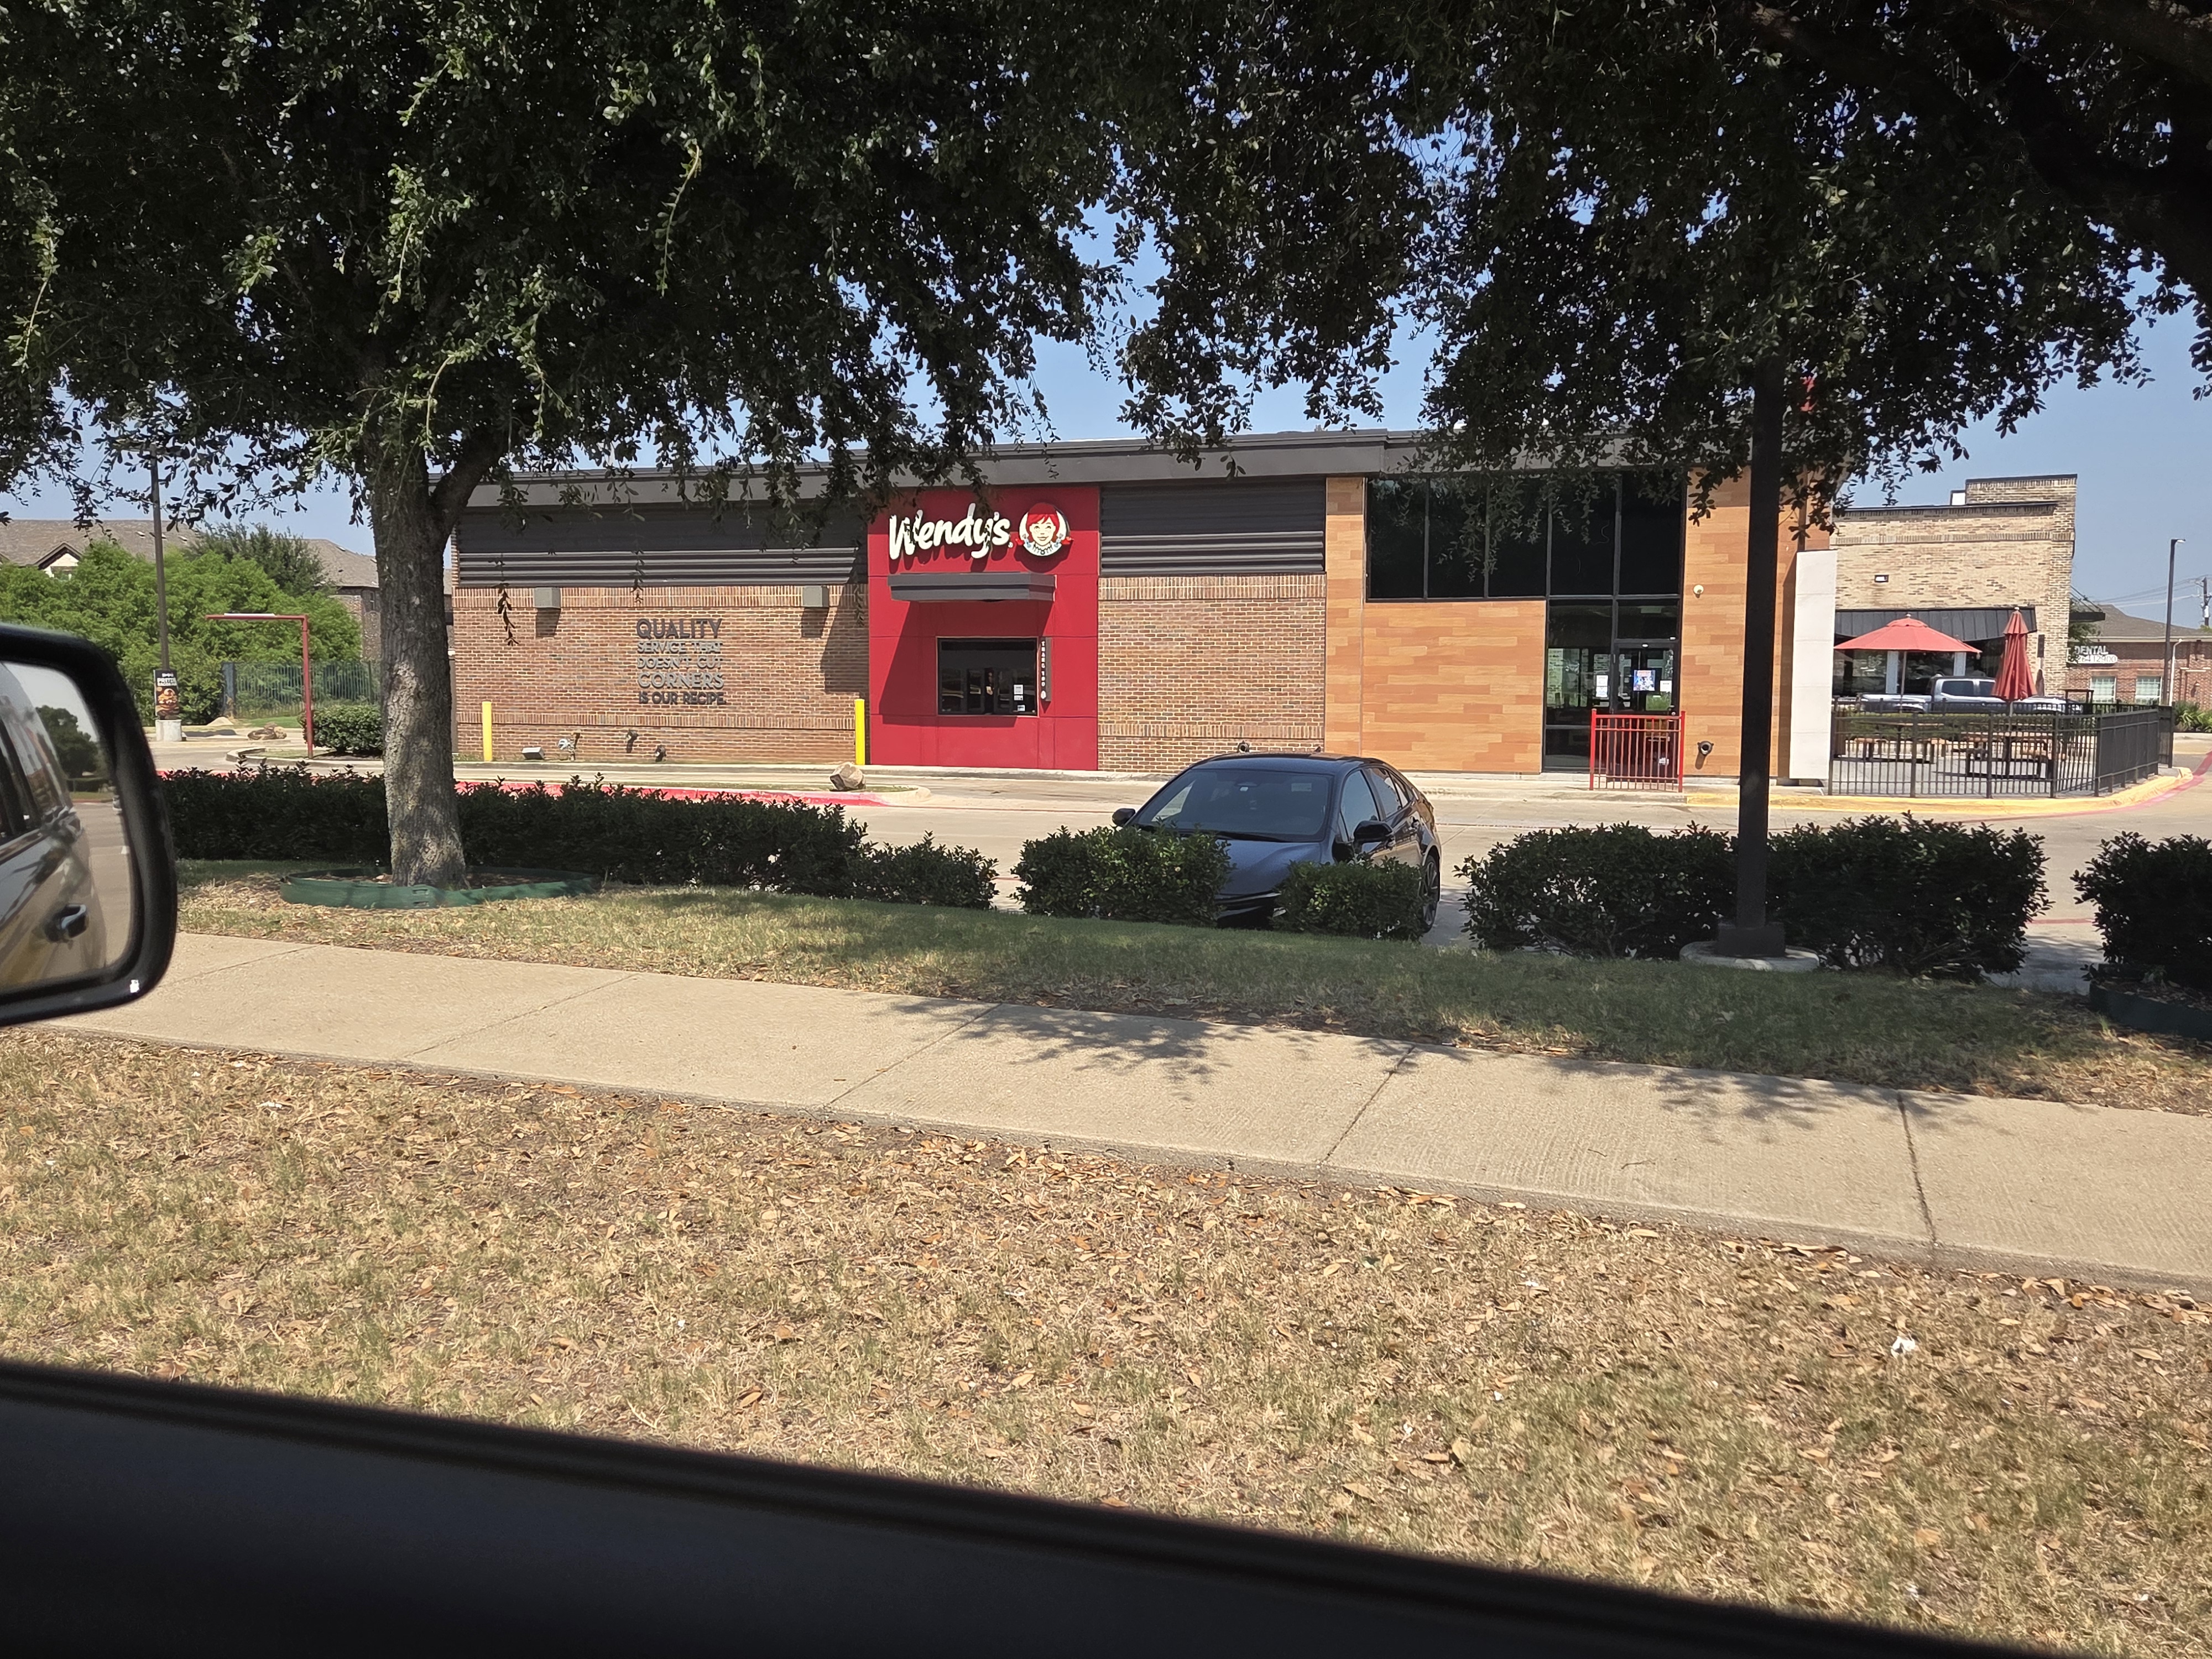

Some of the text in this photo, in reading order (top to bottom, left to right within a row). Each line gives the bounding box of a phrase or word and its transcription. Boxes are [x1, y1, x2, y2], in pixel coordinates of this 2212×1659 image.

[889, 503, 1011, 559] Wendy's
[637, 618, 723, 640] QUALITY
[637, 641, 723, 654] SERVICE THAT
[2074, 645, 2109, 655] DENTAL
[637, 656, 723, 669] DOESN'T CUT
[638, 672, 724, 689] CORNERS
[639, 692, 649, 704] IS
[652, 692, 678, 705] OUR
